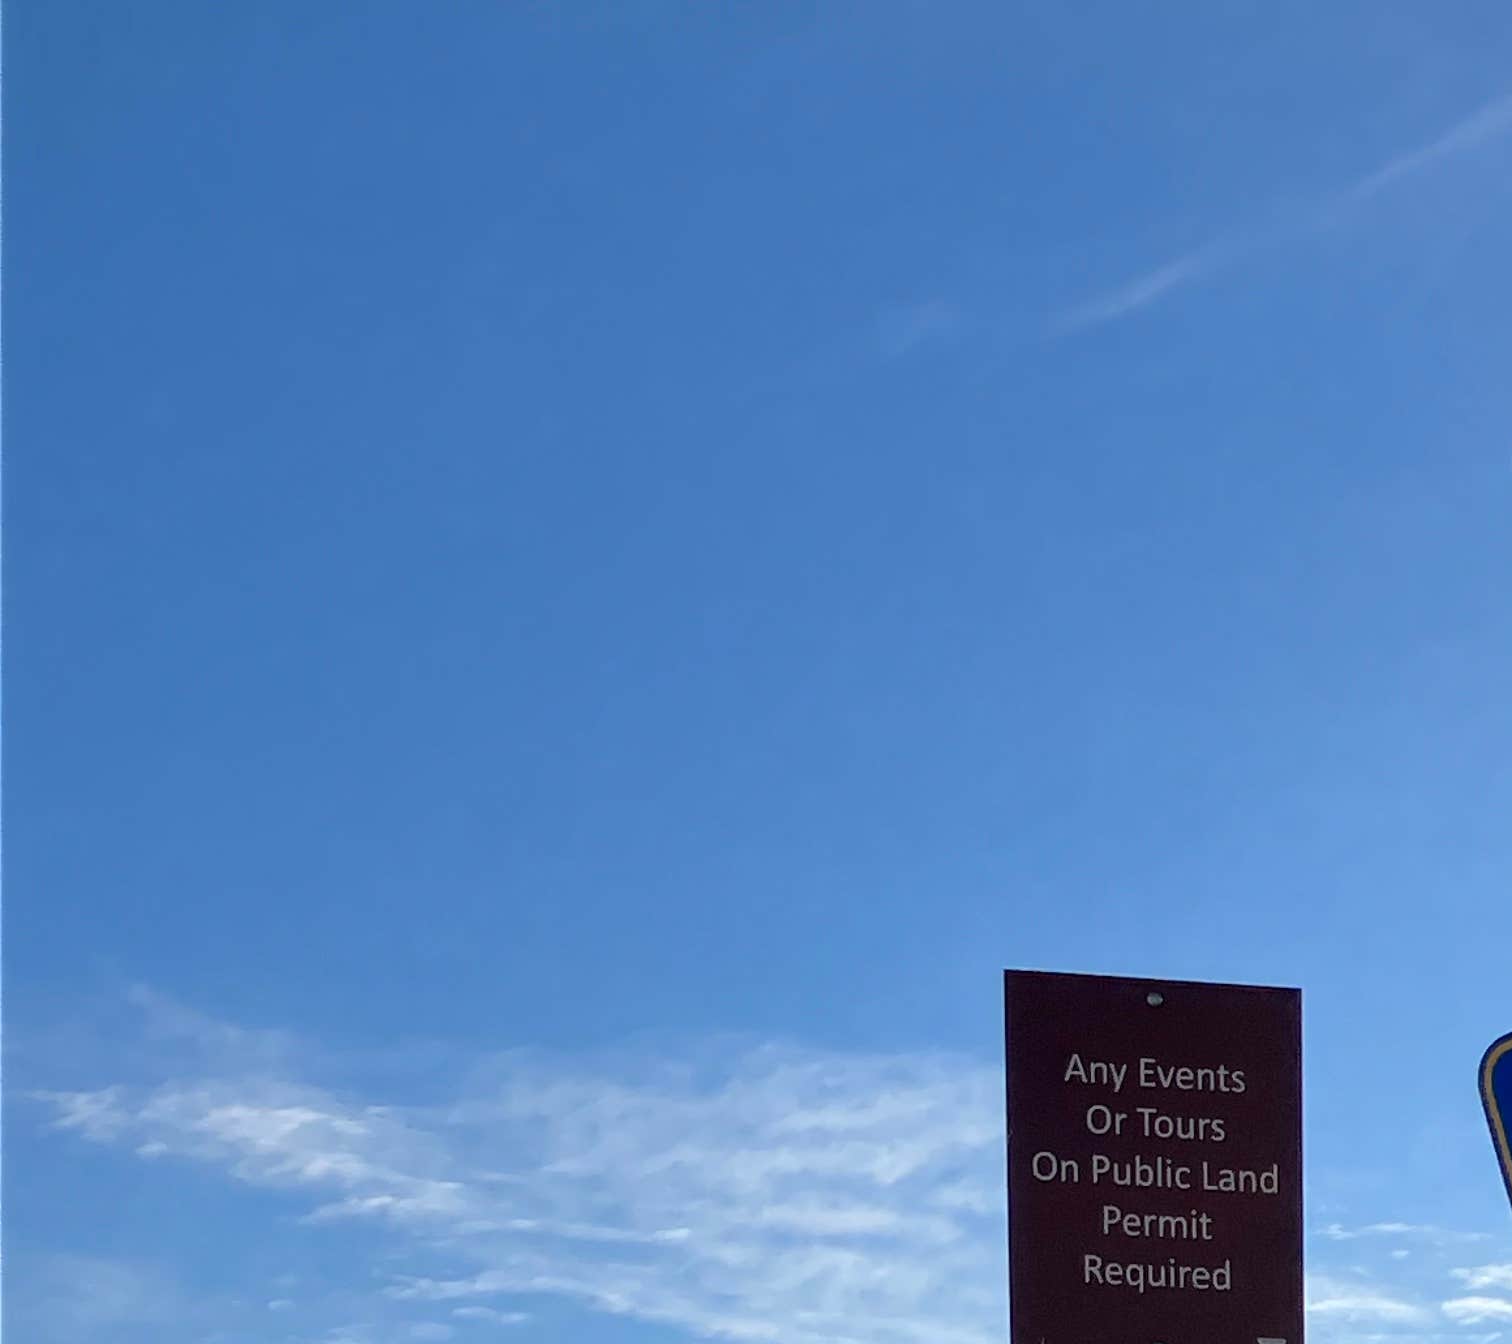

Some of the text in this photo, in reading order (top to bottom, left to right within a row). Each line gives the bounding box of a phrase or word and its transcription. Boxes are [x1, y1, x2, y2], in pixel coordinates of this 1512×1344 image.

[1063, 1053, 1246, 1094] Any Events
[1086, 1104, 1226, 1142] Or Tours
[1032, 1151, 1280, 1194] On Public Land
[1103, 1205, 1212, 1240] Permit
[1084, 1254, 1232, 1294] Required
